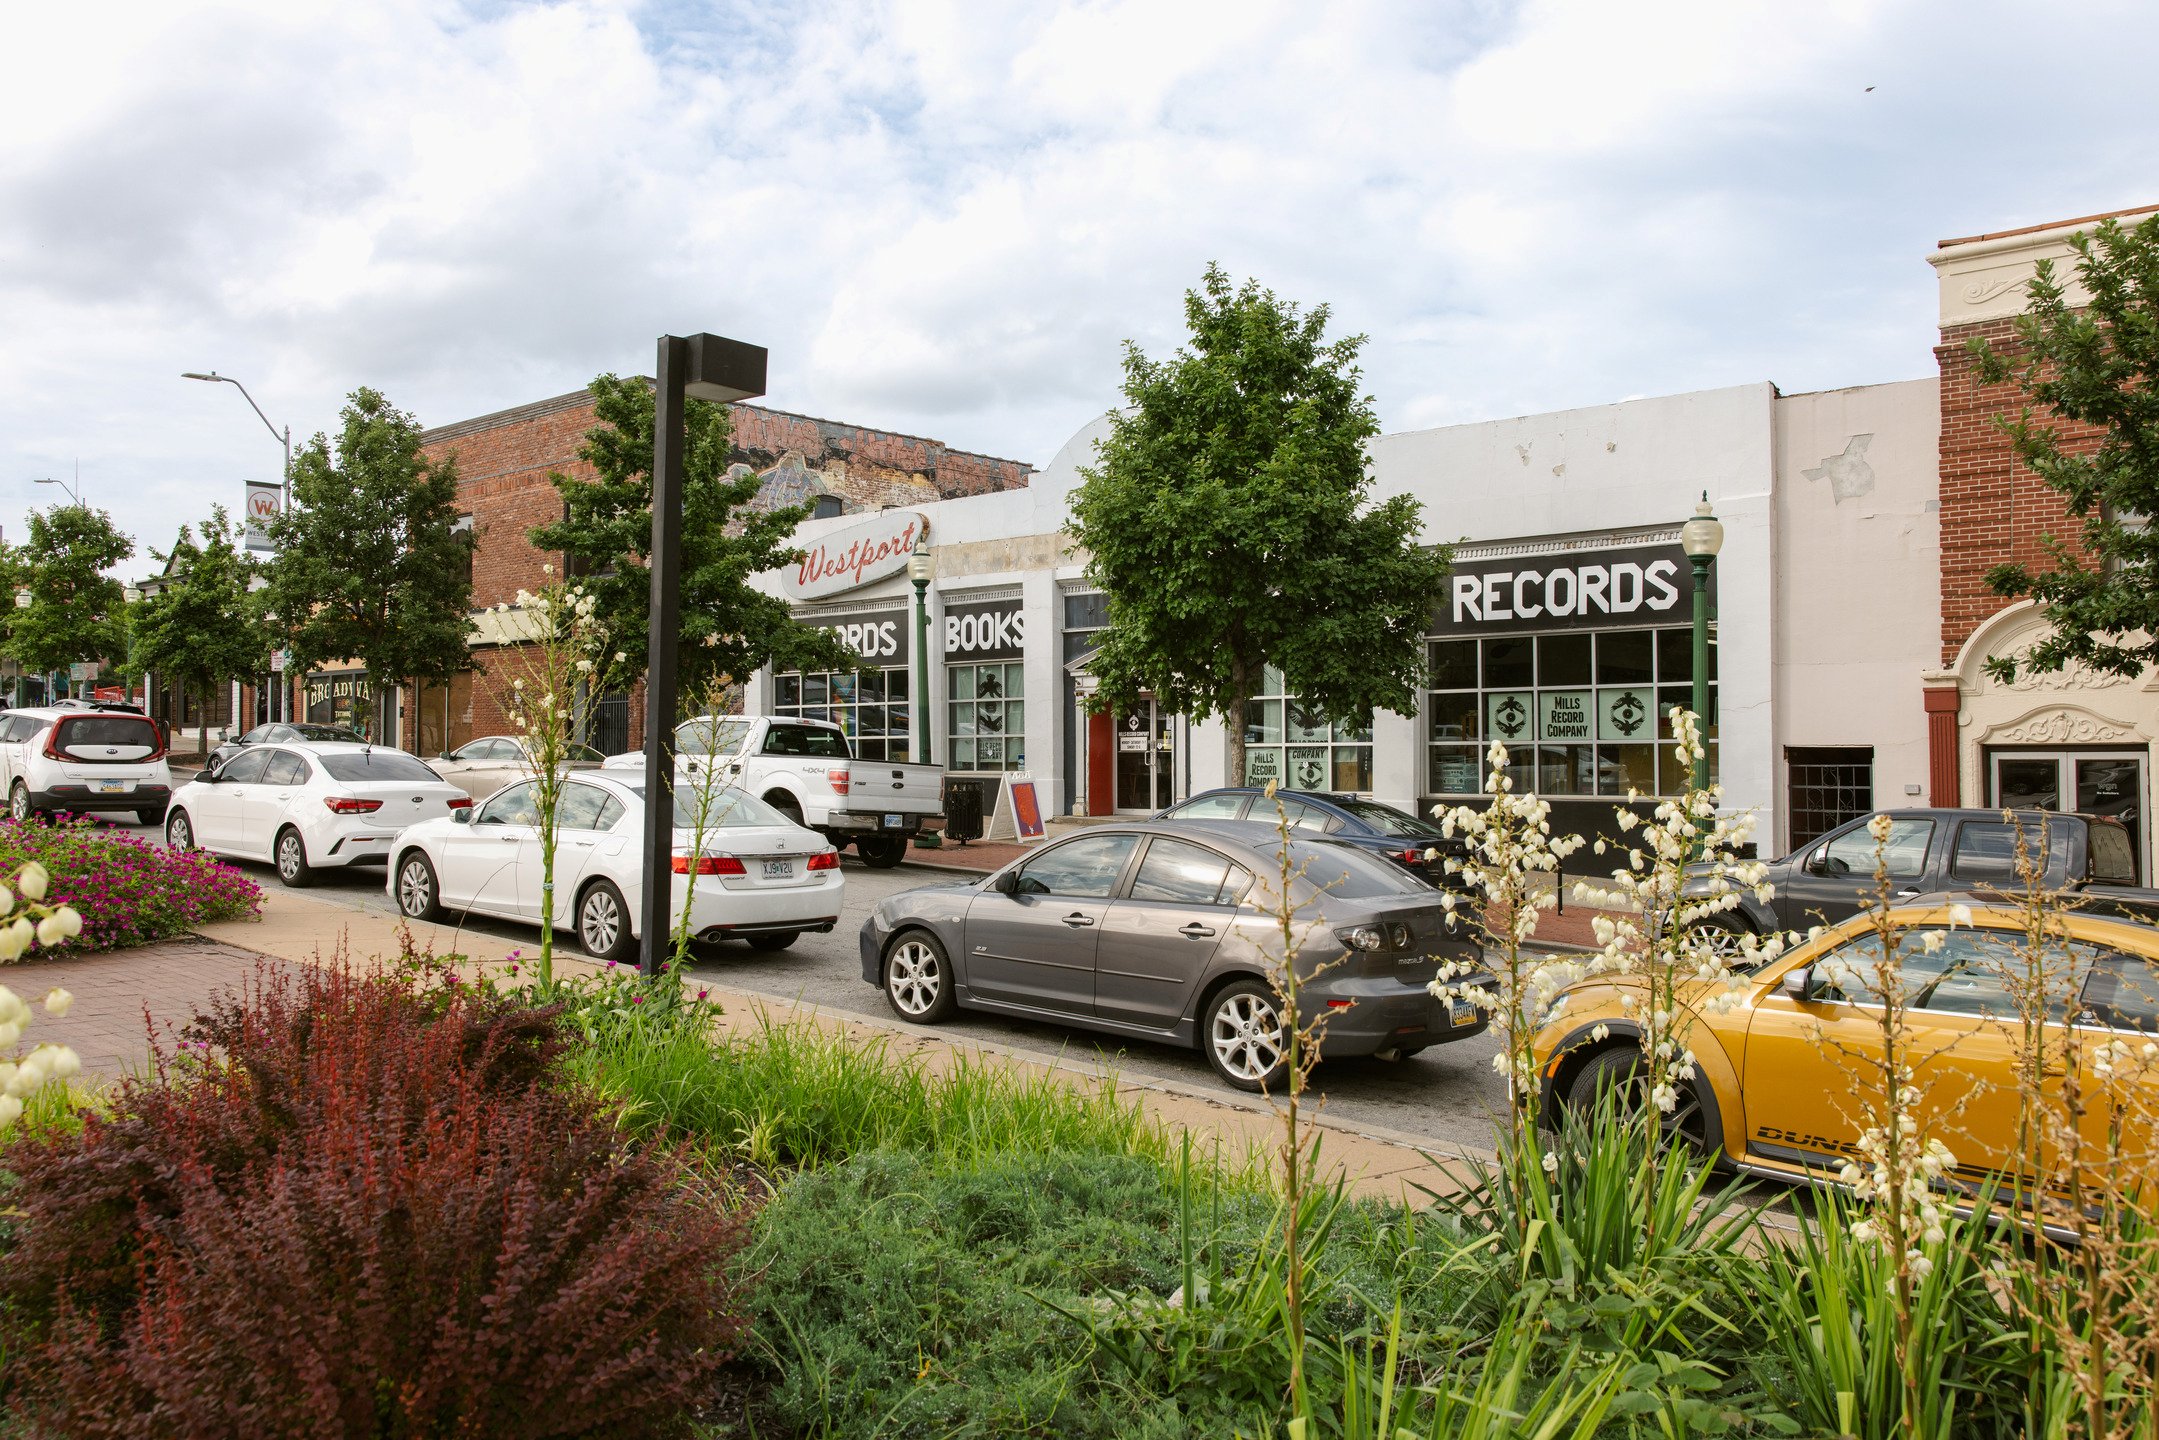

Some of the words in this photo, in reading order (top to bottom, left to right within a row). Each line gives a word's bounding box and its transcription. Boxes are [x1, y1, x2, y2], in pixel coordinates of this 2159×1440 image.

[253, 499, 274, 516] W
[248, 530, 269, 538] WESTP
[794, 522, 914, 585] Westport
[1453, 559, 1679, 623] RECORDS
[945, 610, 1024, 652] BOOKS
[817, 621, 897, 657] ORDS
[1554, 696, 1580, 710] MILLS
[1551, 710, 1584, 723] RECORD
[1547, 724, 1588, 737] COMPANY
[1254, 752, 1274, 763] MILLS
[1252, 764, 1277, 775] RECORD
